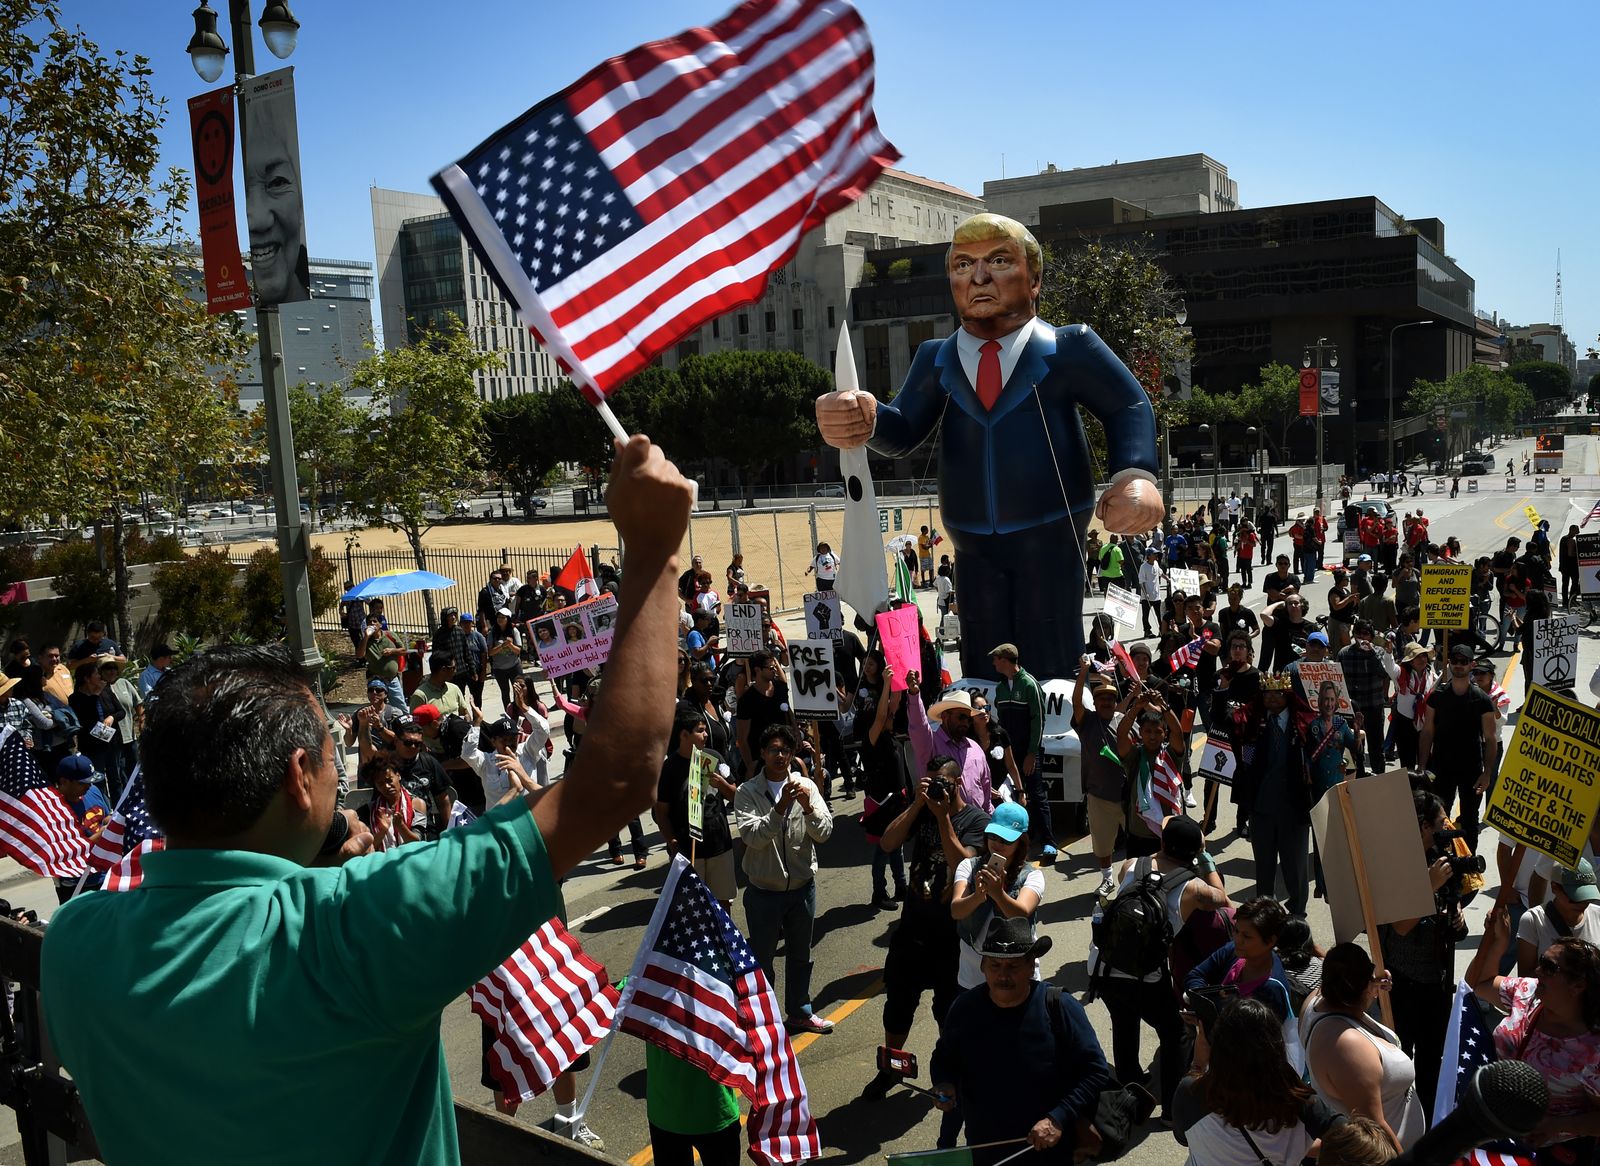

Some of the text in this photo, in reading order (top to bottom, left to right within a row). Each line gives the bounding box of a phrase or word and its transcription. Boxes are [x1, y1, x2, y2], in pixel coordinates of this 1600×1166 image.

[914, 206, 959, 231] TIME
[1424, 568, 1469, 576] IMMIGRANTS
[1425, 587, 1467, 595] REFUGEES
[731, 604, 757, 618] END
[1424, 603, 1465, 611] WELCOME
[727, 628, 761, 640] FOR THE
[731, 639, 760, 651] RICH
[1543, 636, 1564, 648] OUR
[557, 647, 573, 659] will
[576, 642, 593, 653] win
[594, 637, 609, 648] this
[788, 645, 830, 668] RISE
[546, 664, 561, 674] the
[562, 657, 583, 670] river
[584, 651, 599, 663] told
[794, 668, 835, 702] UP!
[1530, 695, 1556, 724] VOTE
[1520, 722, 1541, 742] SAY
[1540, 732, 1560, 752] NO
[1562, 741, 1581, 760] TO
[1519, 741, 1595, 787] CANDIDATES
[1519, 768, 1573, 805] OF WALL
[1502, 777, 1586, 829] STREET & THE
[1490, 808, 1553, 850] VotePSL.org
[1502, 796, 1573, 841] PENTAGON!
